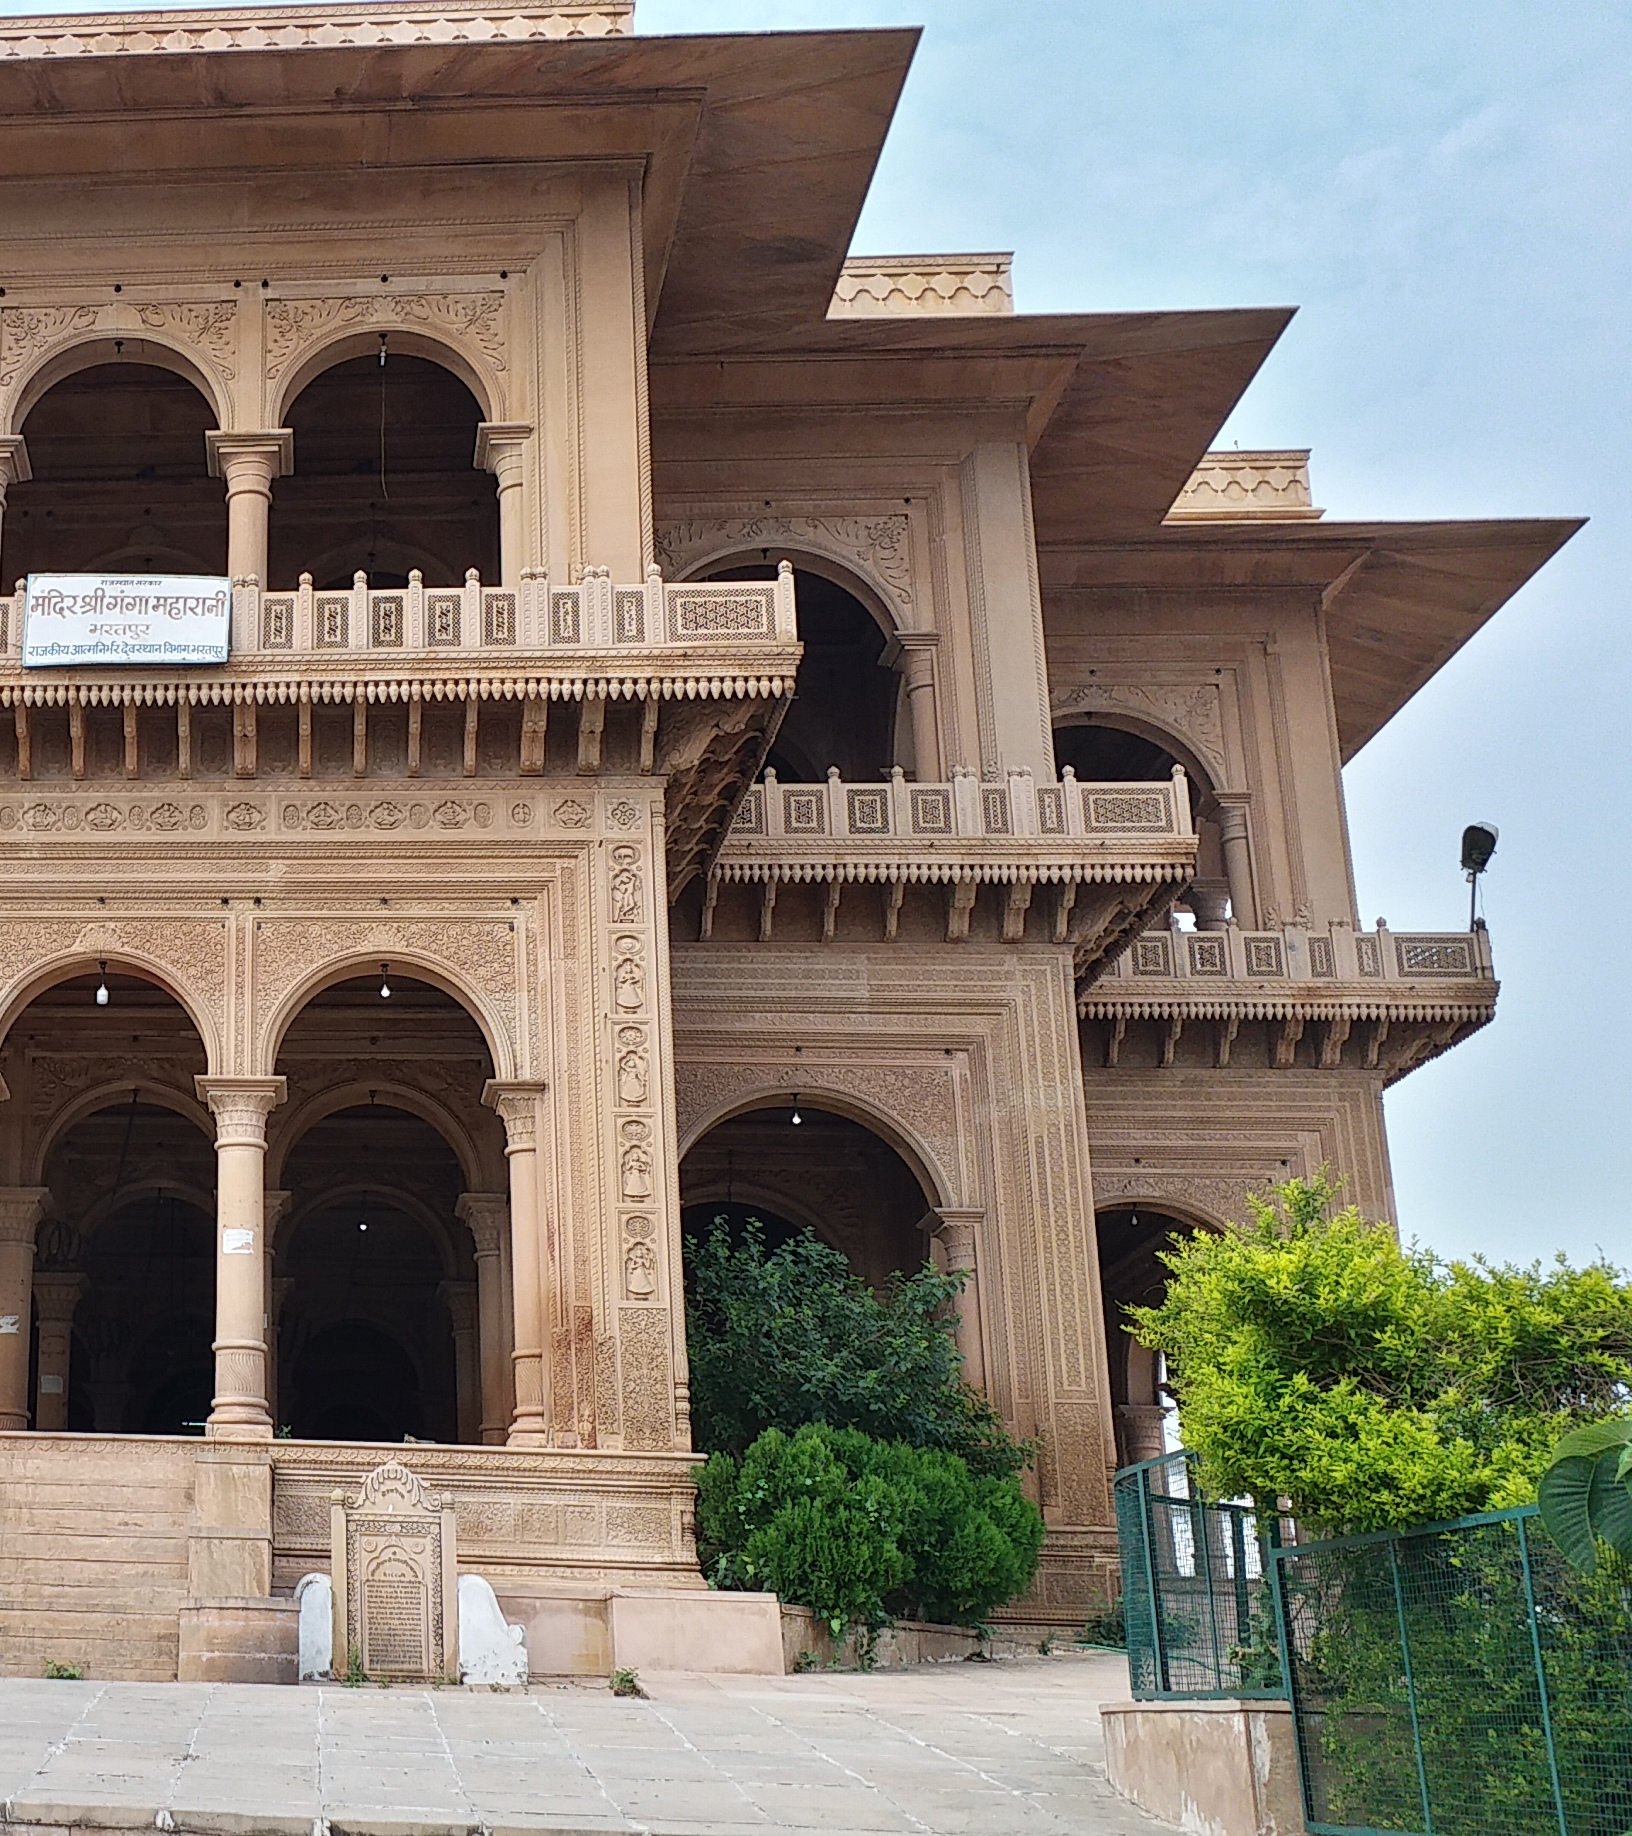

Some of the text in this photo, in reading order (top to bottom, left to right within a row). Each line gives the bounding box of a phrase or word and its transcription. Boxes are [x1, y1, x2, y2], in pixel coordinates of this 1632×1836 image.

[30, 587, 227, 620] मंदिर श्री गंगा महारानी
[89, 623, 151, 639] भरतपुर
[28, 642, 70, 656] राजकीय
[70, 640, 120, 655] आत्मनिर्भर
[121, 641, 162, 656] देवस्थान
[191, 645, 224, 658] भरतपुर
